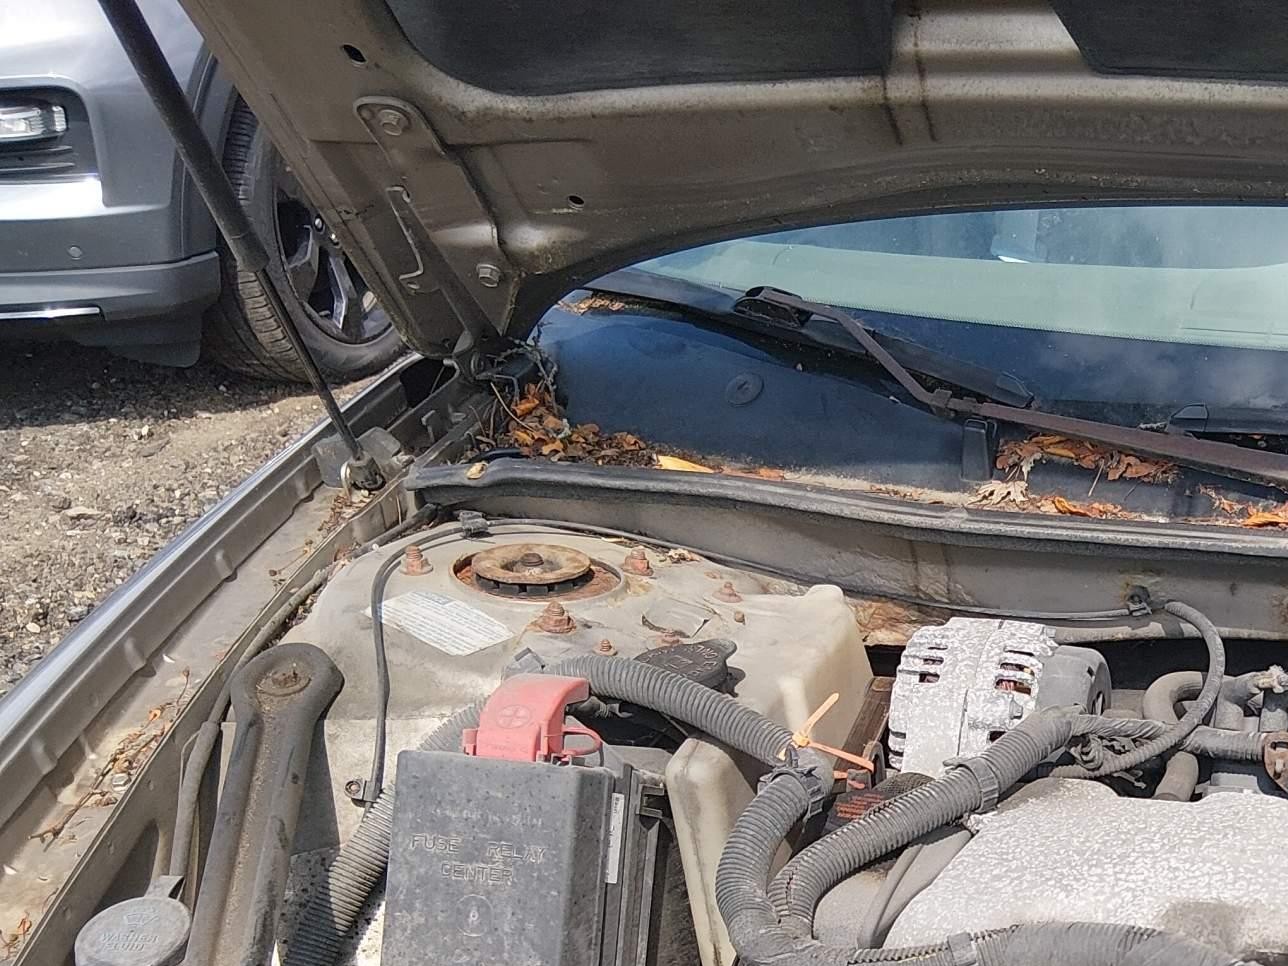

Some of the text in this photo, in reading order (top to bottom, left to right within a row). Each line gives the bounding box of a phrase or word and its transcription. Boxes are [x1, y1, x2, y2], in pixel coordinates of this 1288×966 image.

[408, 832, 548, 864] FUSE RELAY
[441, 861, 513, 885] CENTER
